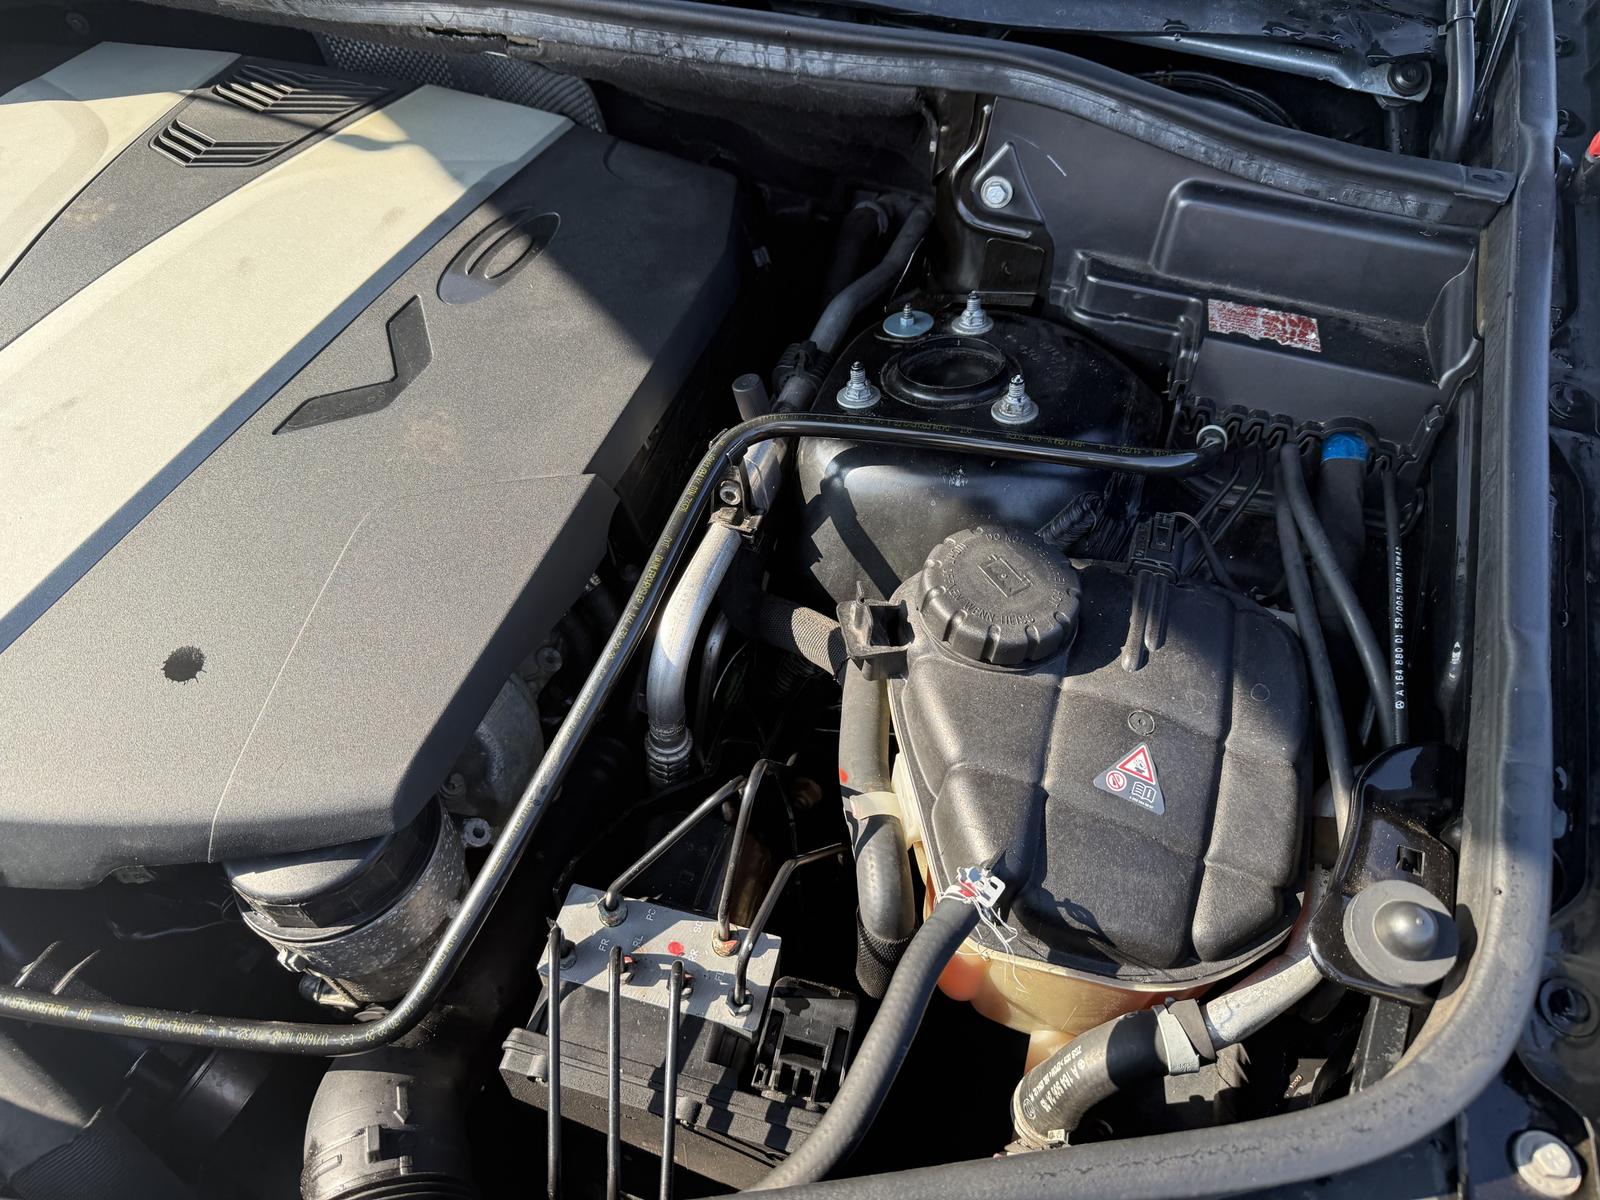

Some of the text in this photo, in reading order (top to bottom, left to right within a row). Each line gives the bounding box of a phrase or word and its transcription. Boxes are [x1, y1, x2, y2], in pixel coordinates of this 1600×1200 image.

[1394, 647, 1404, 666] 880
[1395, 669, 1405, 686] 164
[1396, 689, 1405, 697] A
[598, 938, 610, 952] FR
[1070, 1064, 1081, 1080] A
